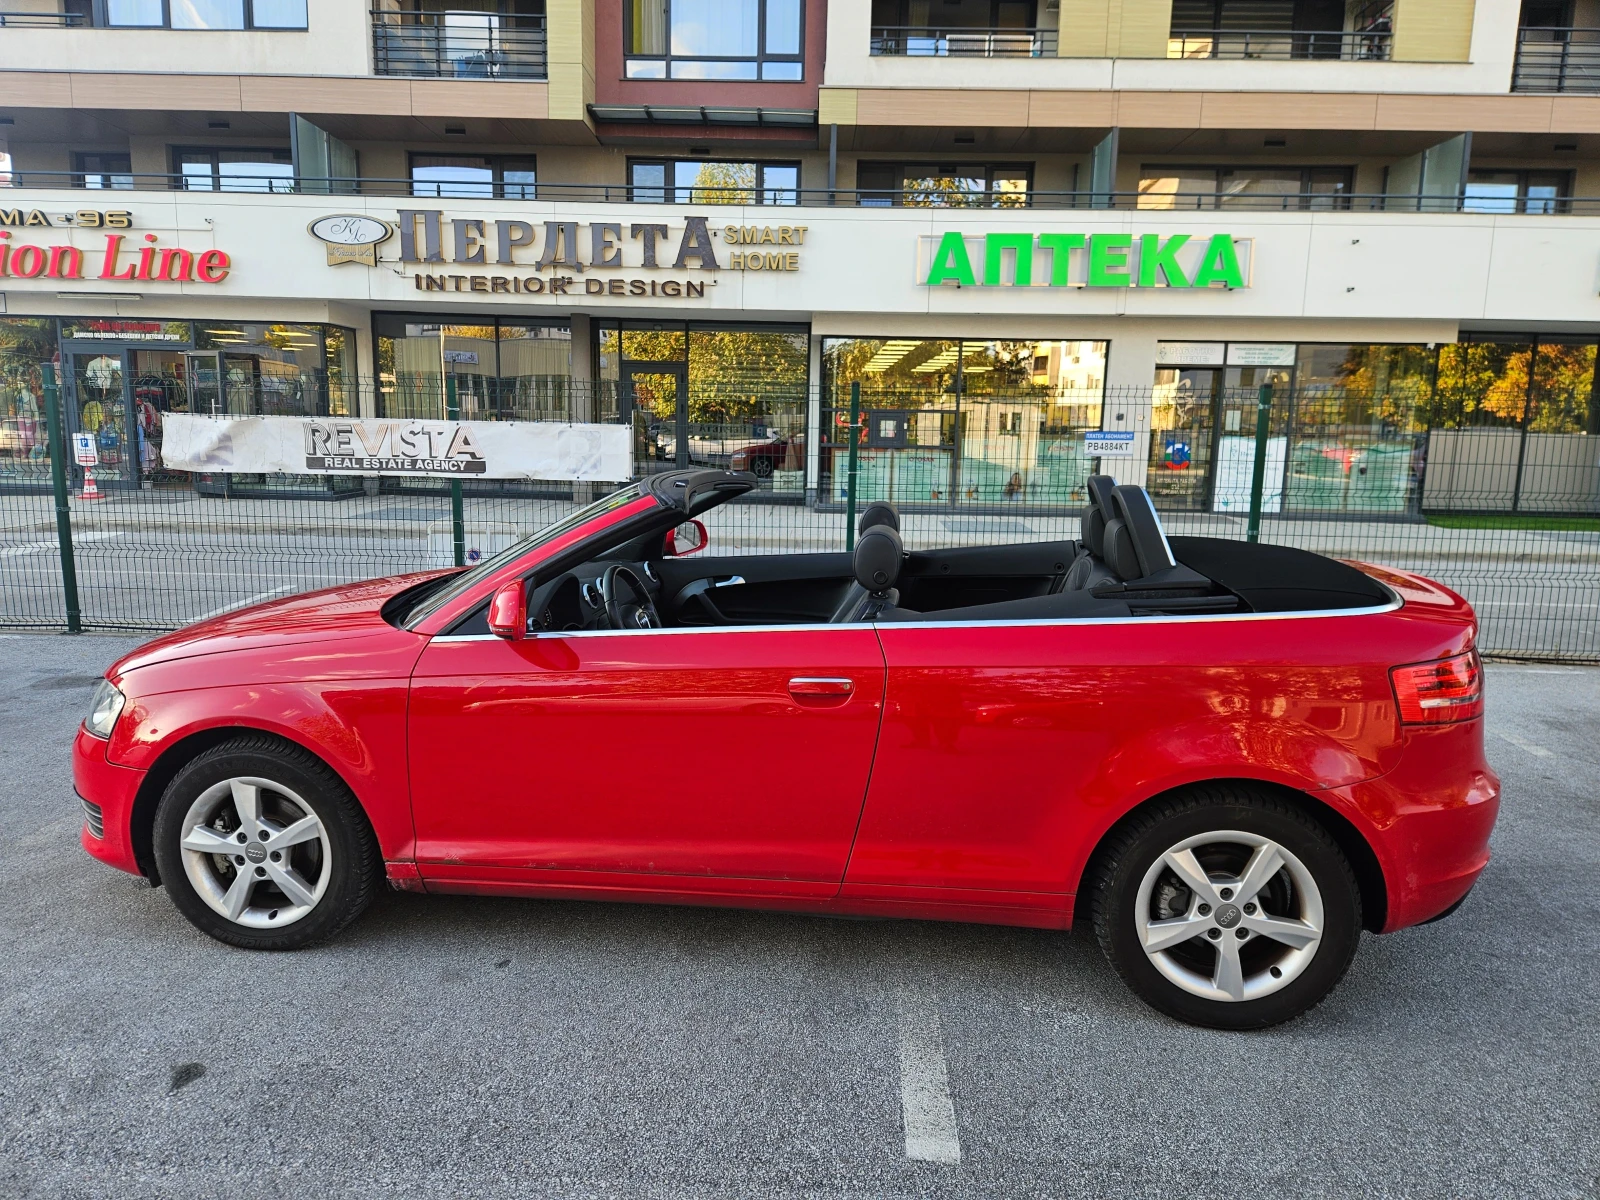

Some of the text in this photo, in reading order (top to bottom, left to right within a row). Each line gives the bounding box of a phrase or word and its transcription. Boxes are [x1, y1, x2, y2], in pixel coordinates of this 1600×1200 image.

[396, 209, 720, 273] ПЕРДЕТА
[723, 225, 808, 245] SMART
[97, 234, 231, 283] Line
[730, 252, 799, 271] HOME
[926, 231, 1244, 287] АПТЕКА
[414, 273, 704, 297] INTERIOR DESIGN
[302, 422, 486, 460] REVISTA
[324, 457, 466, 471] REAL ESTATE AGENCY
